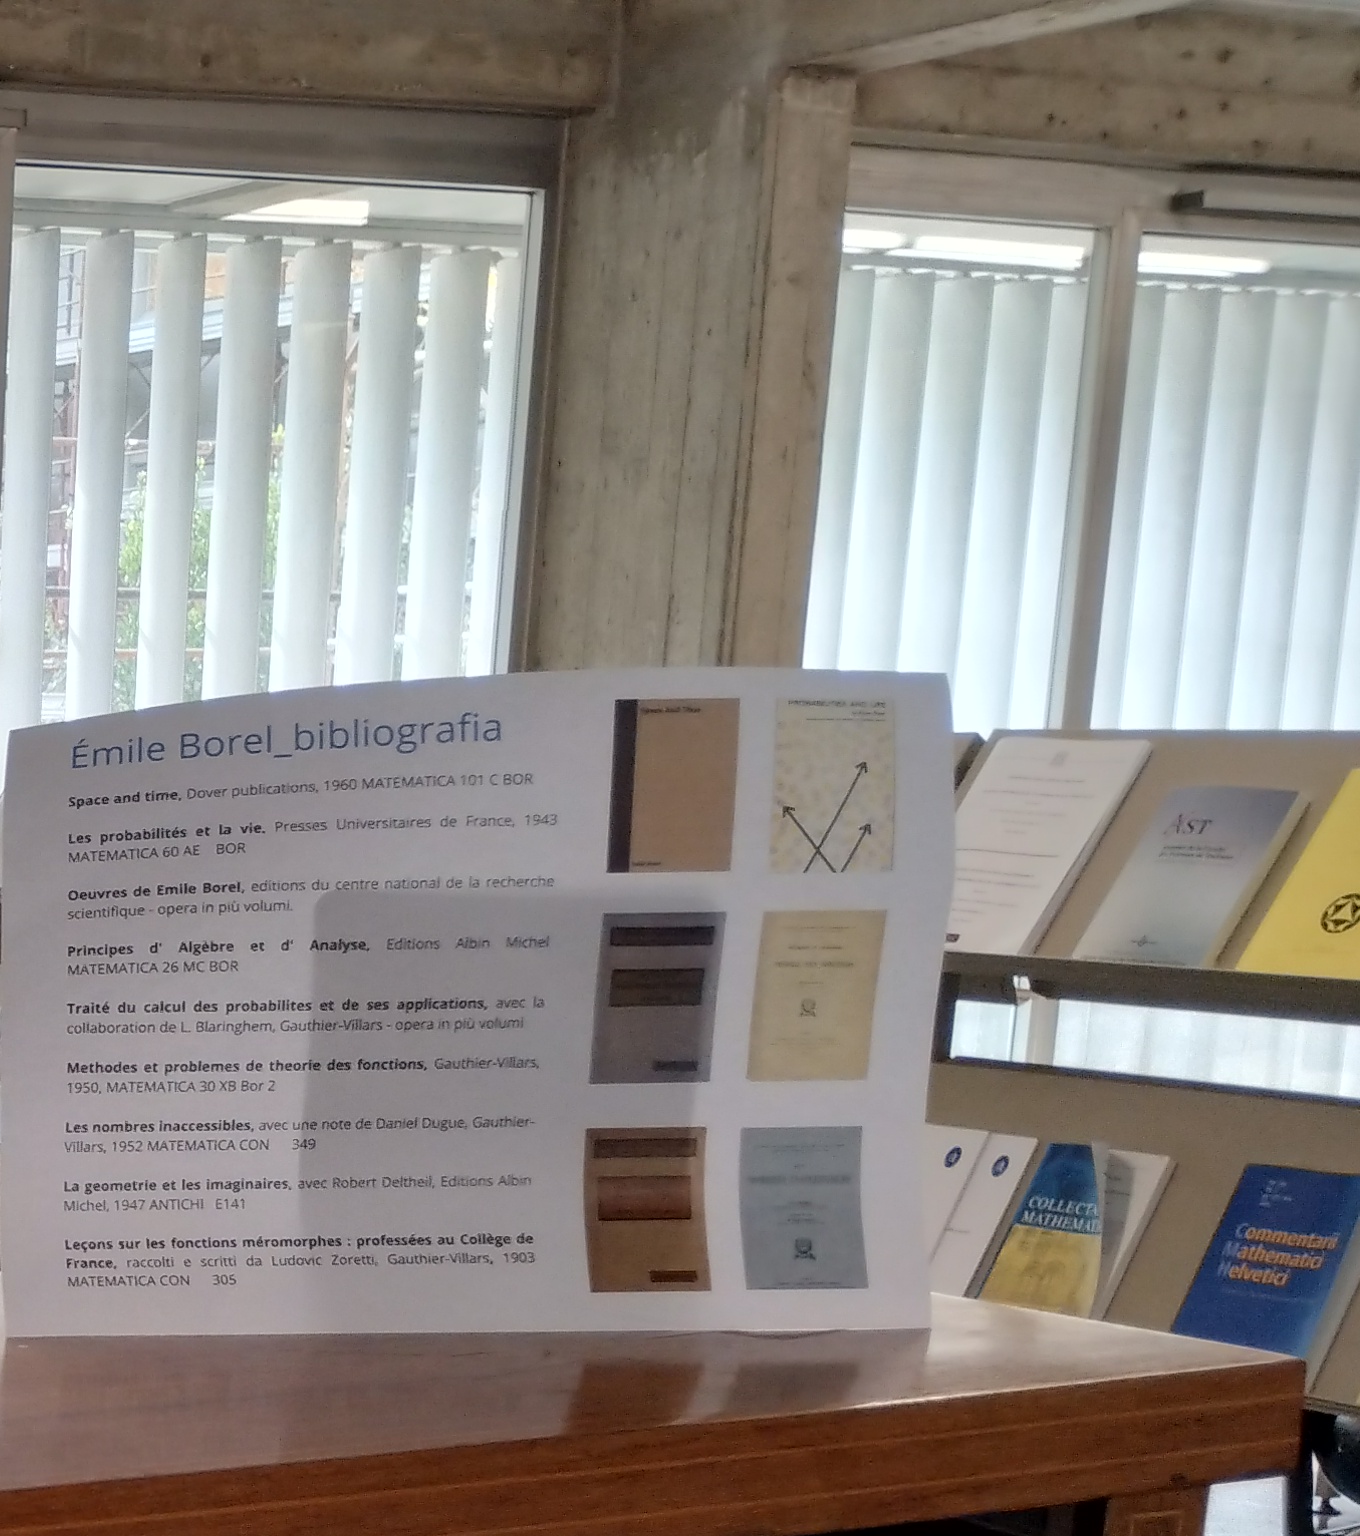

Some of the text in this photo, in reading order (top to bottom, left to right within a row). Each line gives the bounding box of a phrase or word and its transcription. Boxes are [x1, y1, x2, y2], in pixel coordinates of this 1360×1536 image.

[69, 711, 503, 771] Émile Borel_bibliografia
[68, 796, 110, 810] Space
[113, 791, 141, 804] and
[144, 790, 182, 802] time,
[186, 787, 228, 800] Dover
[231, 783, 319, 799] publications,
[324, 778, 358, 792] 1960
[361, 775, 456, 790] MATEMATICA
[460, 774, 483, 786] 101
[502, 773, 534, 786] BOR
[68, 842, 247, 863] MATEMATICA 60 AE BOR
[66, 996, 545, 1016] Traité du calcul des probabilites et de ses applications, avec la
[67, 1061, 138, 1074] Methodes
[143, 1062, 159, 1074] et
[164, 1060, 240, 1077] problemes
[245, 1059, 263, 1072] de
[269, 1059, 322, 1072] theorie
[326, 1058, 352, 1071] des
[357, 1058, 428, 1072] fonctions,
[112, 1140, 143, 1153] 1952
[147, 1139, 237, 1152] MATEMATICA
[239, 1138, 270, 1151] CON
[292, 1138, 317, 1151] 349
[64, 1232, 534, 1254] Leçons sur les fonctions méromorphes professées au Collège de
[67, 1273, 237, 1288] MATEMATICA CON 305
